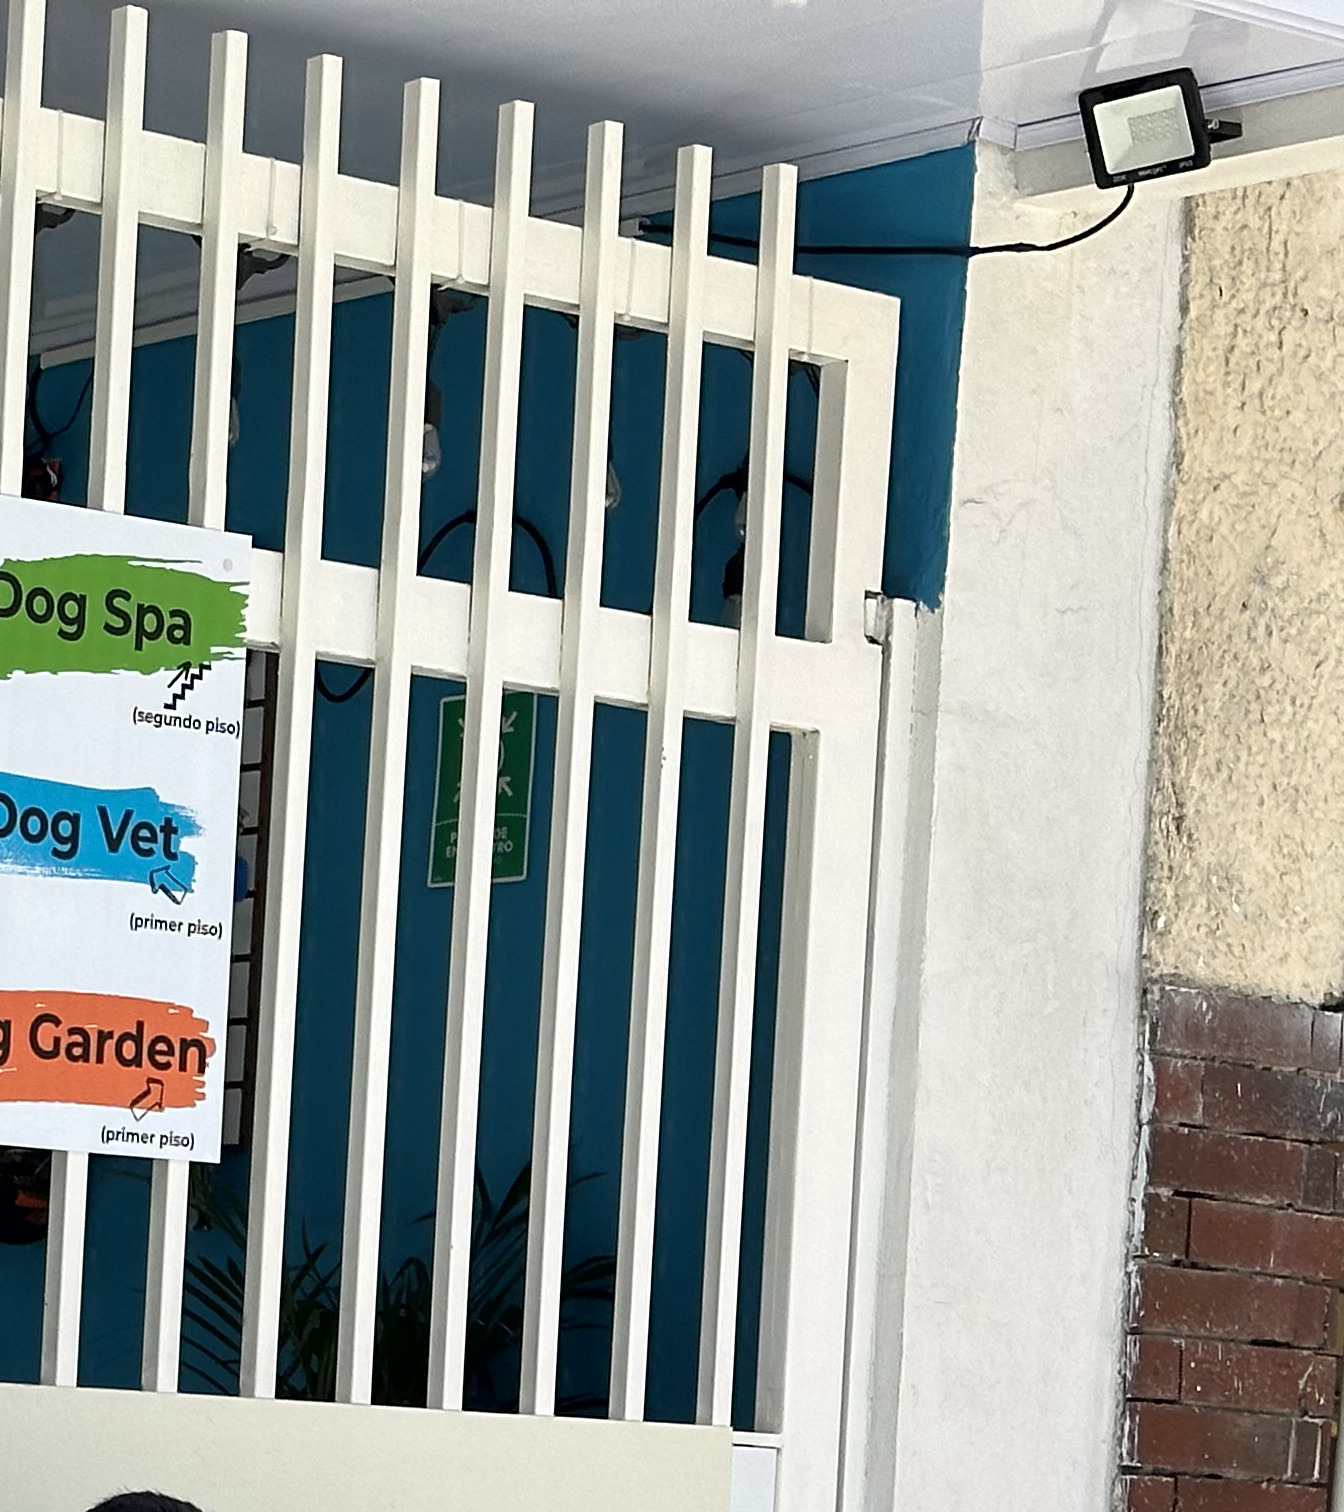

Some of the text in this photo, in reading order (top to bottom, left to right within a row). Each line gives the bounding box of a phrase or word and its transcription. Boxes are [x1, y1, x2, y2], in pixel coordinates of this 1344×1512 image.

[103, 588, 192, 651] Spa
[133, 706, 240, 739] (segundo piso)
[97, 804, 179, 861] Vet
[129, 912, 223, 939] (primer piso)
[29, 1012, 207, 1074] Garden
[101, 1126, 195, 1150] (primer piso)
